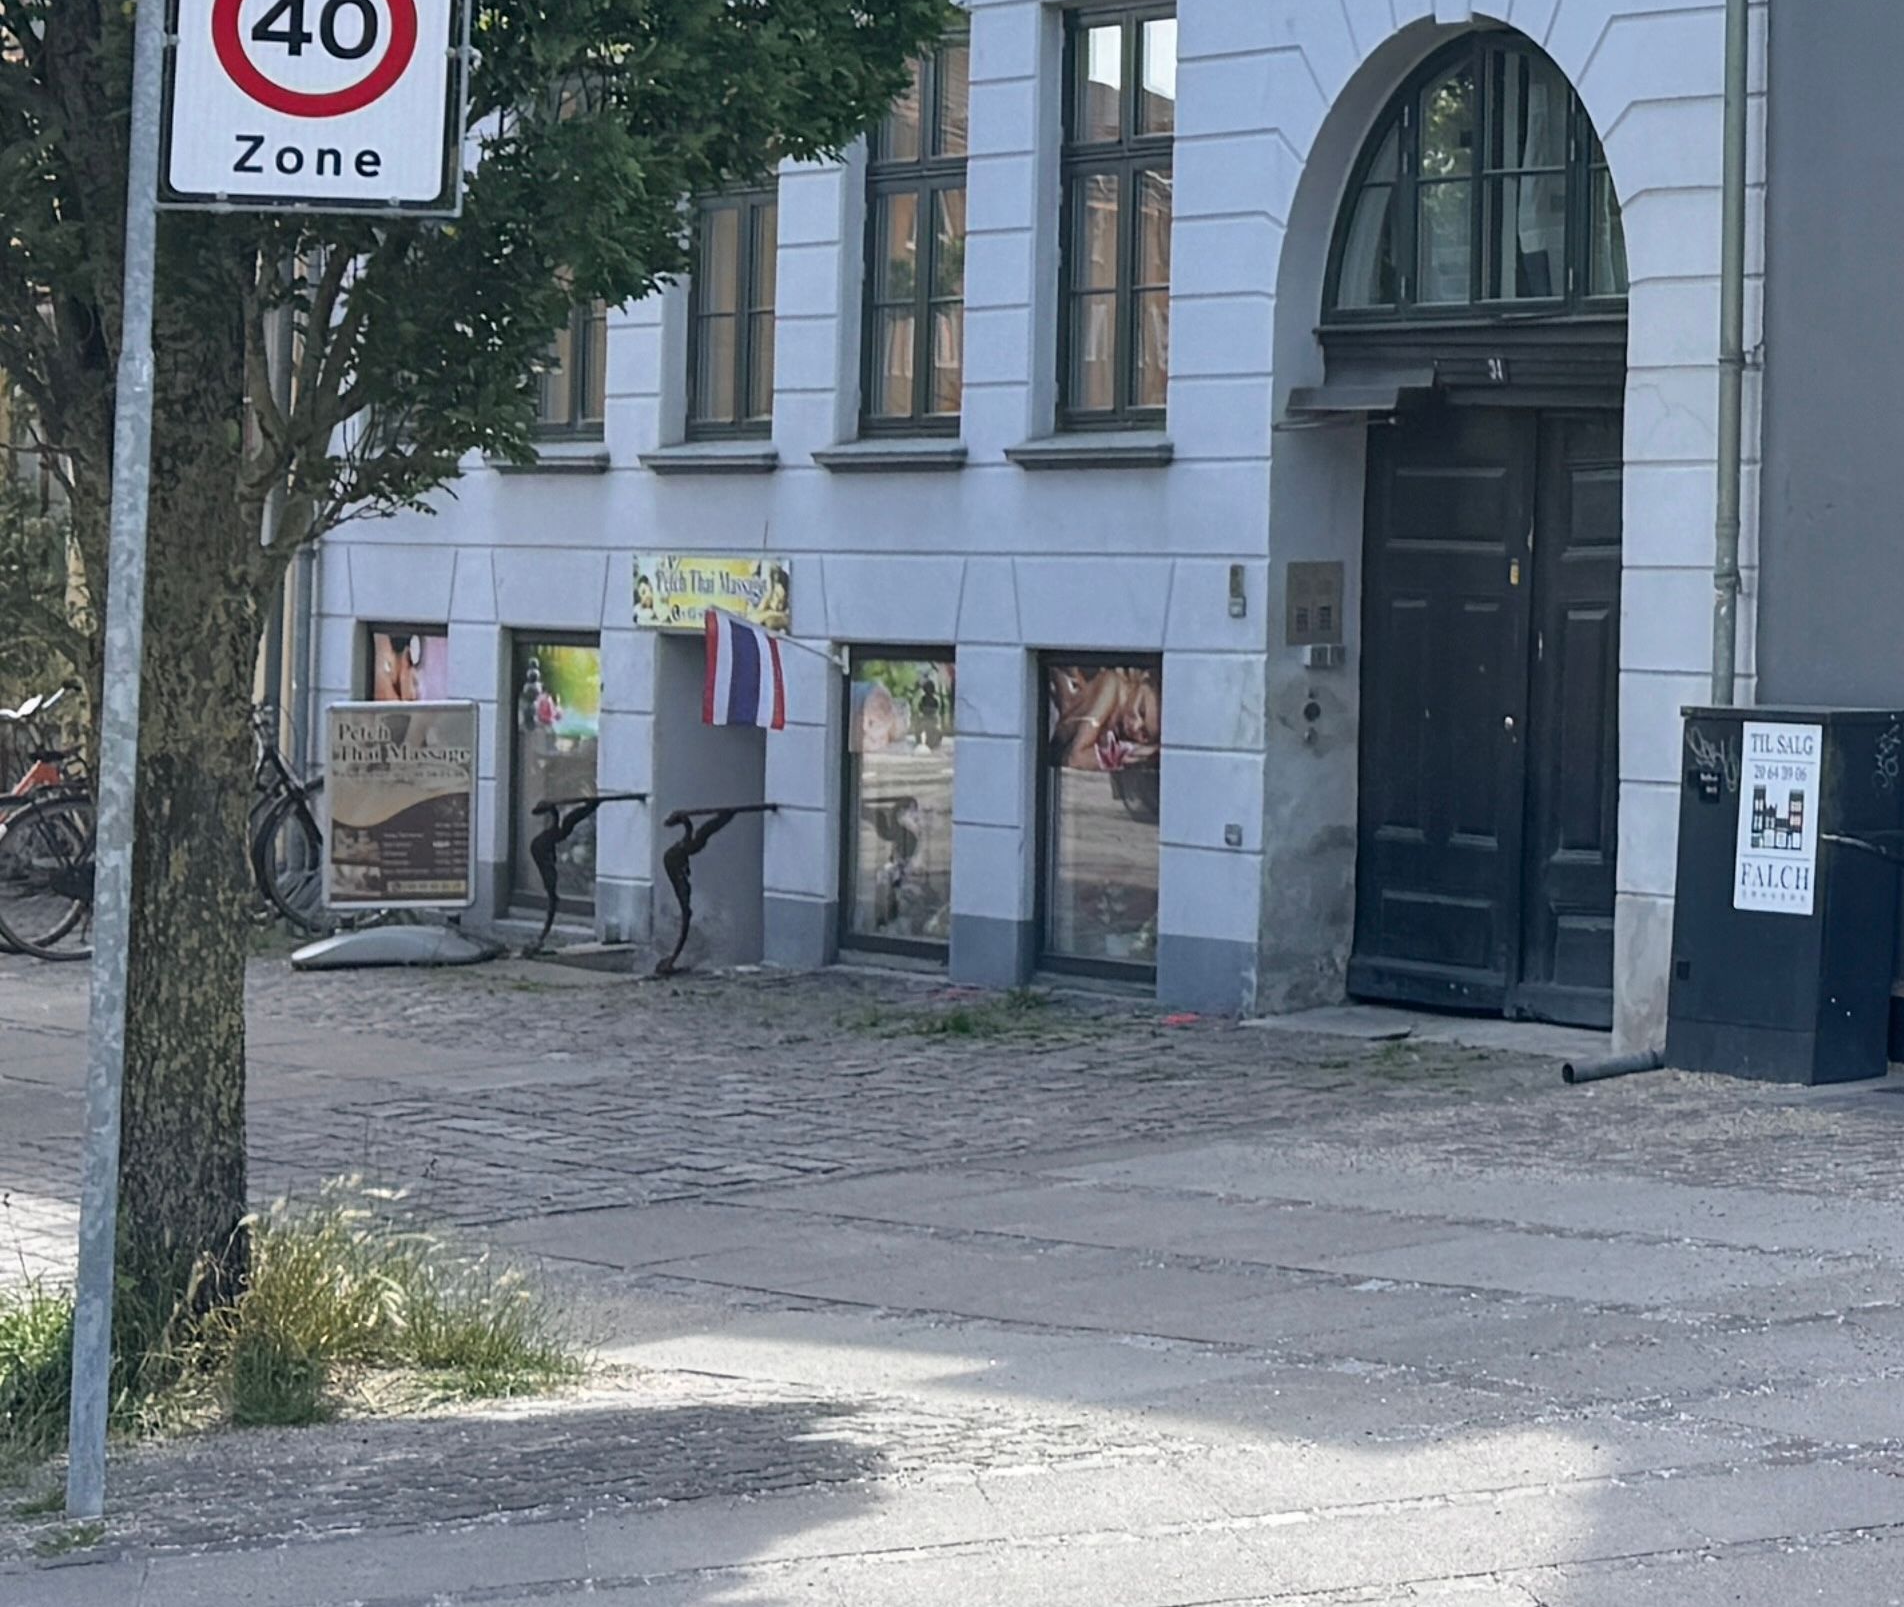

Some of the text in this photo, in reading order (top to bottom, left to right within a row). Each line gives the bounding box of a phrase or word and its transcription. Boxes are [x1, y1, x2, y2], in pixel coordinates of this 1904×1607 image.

[233, 134, 382, 177] Zone
[690, 569, 715, 594] Thai
[719, 570, 768, 605] Massage
[338, 722, 391, 741] Petch
[1750, 733, 1814, 756] TIL SALG
[338, 744, 471, 764] Thai Massage
[1741, 862, 1810, 891] FALCH
